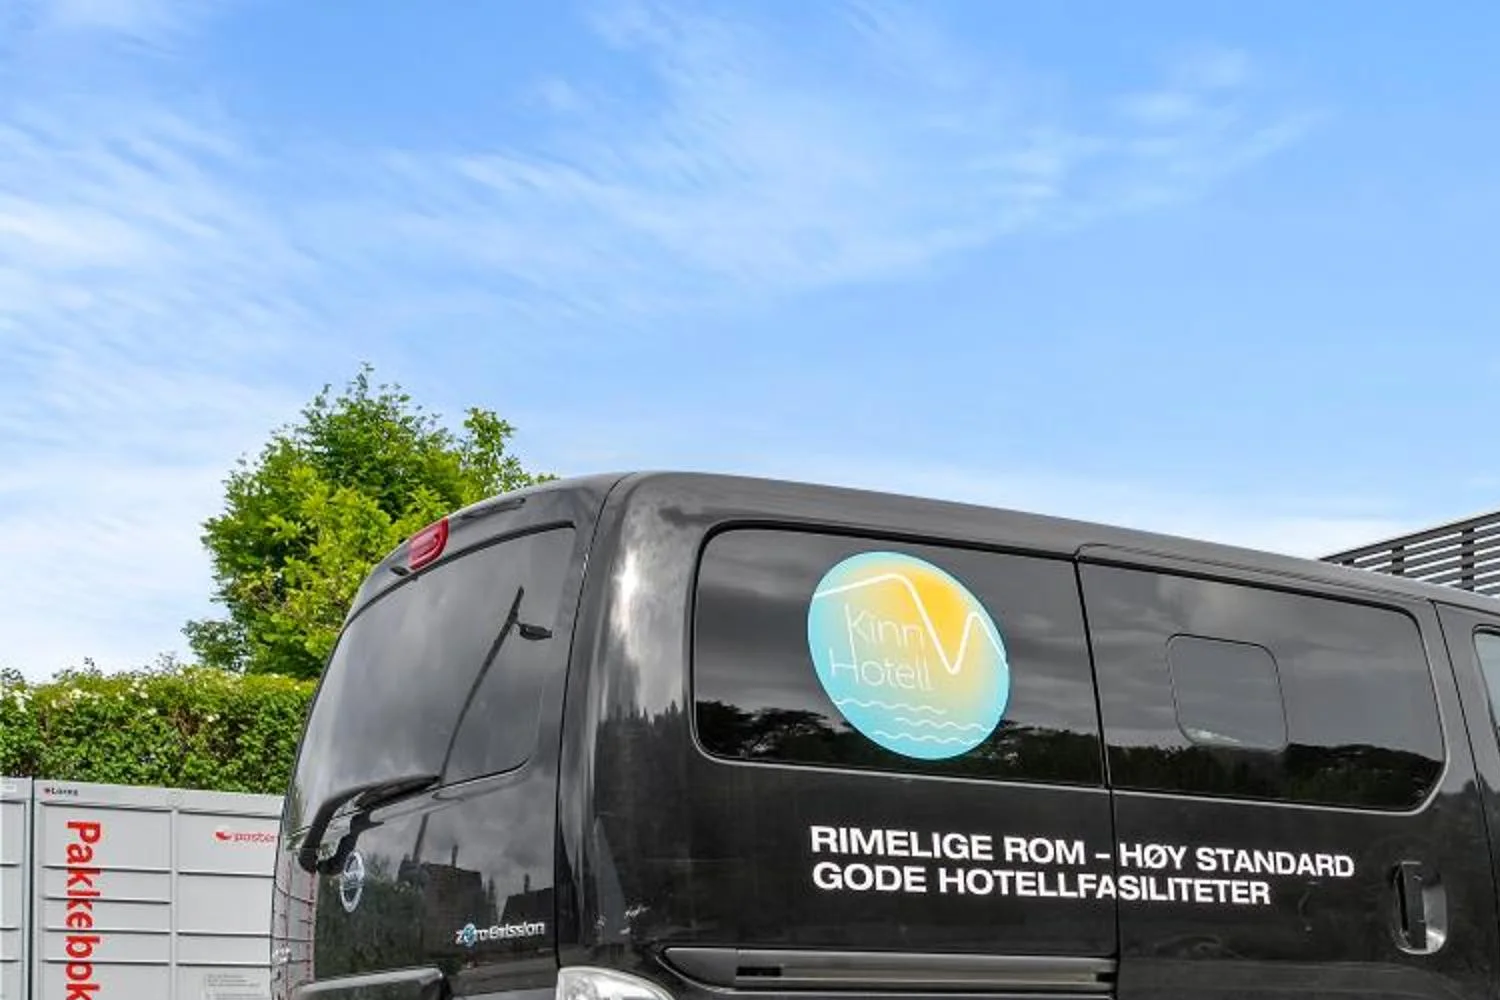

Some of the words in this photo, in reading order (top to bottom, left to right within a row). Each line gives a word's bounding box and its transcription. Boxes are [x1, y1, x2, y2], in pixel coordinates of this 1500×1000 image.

[844, 603, 924, 648] Kinn
[829, 647, 934, 691] Hotell
[810, 825, 994, 861] RIMELIGE
[1003, 836, 1086, 865] ROM
[1119, 842, 1187, 870] HØY
[1195, 846, 1355, 878] STANDARD
[812, 861, 927, 893] GODE
[938, 867, 1271, 905] HOTELLFASILITETER
